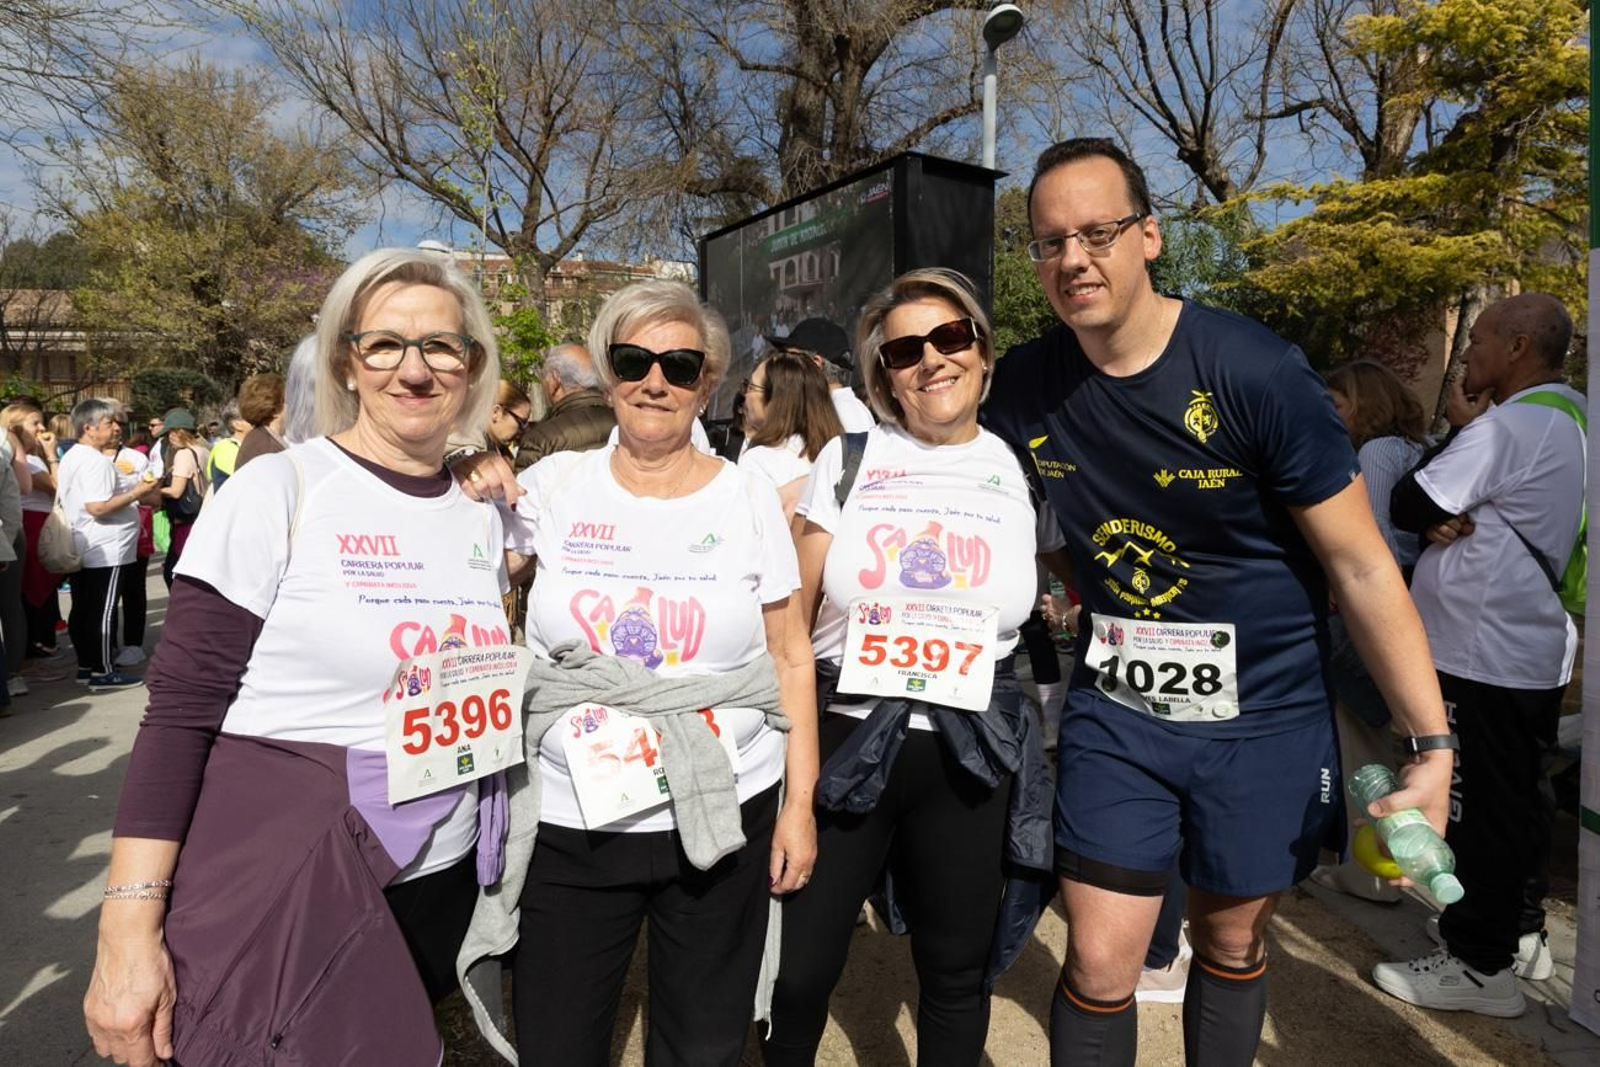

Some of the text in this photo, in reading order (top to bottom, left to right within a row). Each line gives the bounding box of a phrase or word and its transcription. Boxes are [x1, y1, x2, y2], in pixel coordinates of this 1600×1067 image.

[1178, 469, 1206, 479] CAJA
[569, 522, 616, 540] XXVII
[1092, 519, 1177, 552] SENDERISMO
[336, 534, 401, 556] XXVII
[341, 559, 424, 571] CARRERA POPULAR
[1135, 626, 1156, 636] XXVII
[485, 651, 516, 663] POPULAR
[858, 634, 984, 676] 5397
[898, 670, 938, 679] FRANCISCA
[1100, 655, 1223, 696] 1028
[403, 689, 512, 755] 5396
[457, 744, 471, 753] ANA
[1320, 768, 1332, 804] RUN
